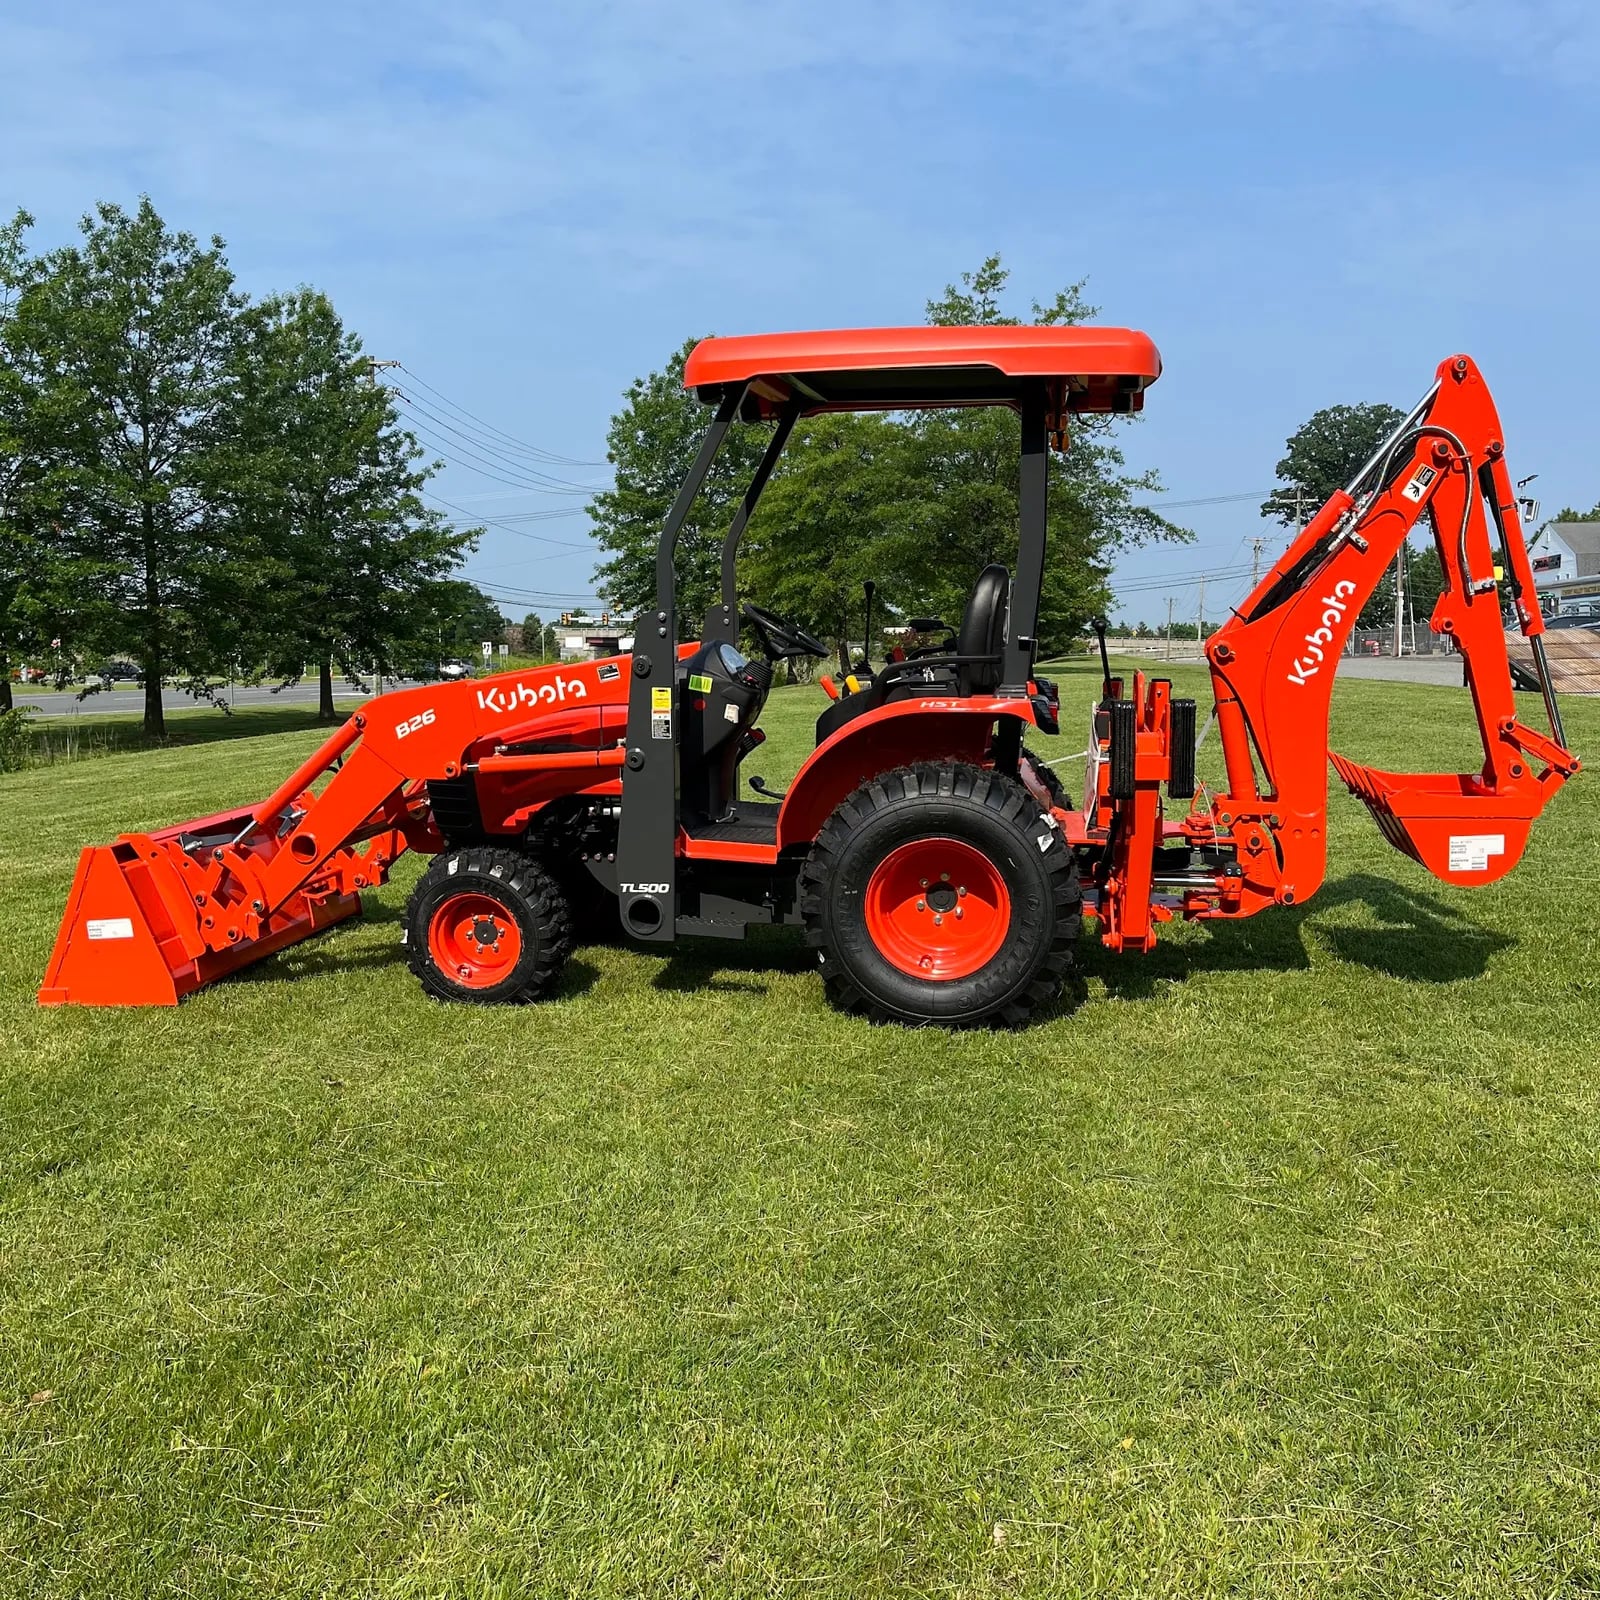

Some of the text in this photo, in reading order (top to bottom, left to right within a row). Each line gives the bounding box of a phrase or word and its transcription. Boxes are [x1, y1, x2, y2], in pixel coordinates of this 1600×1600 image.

[1287, 580, 1357, 686] Kubota
[476, 675, 587, 713] Kubota
[395, 708, 436, 739] B26
[620, 883, 670, 893] TL500
